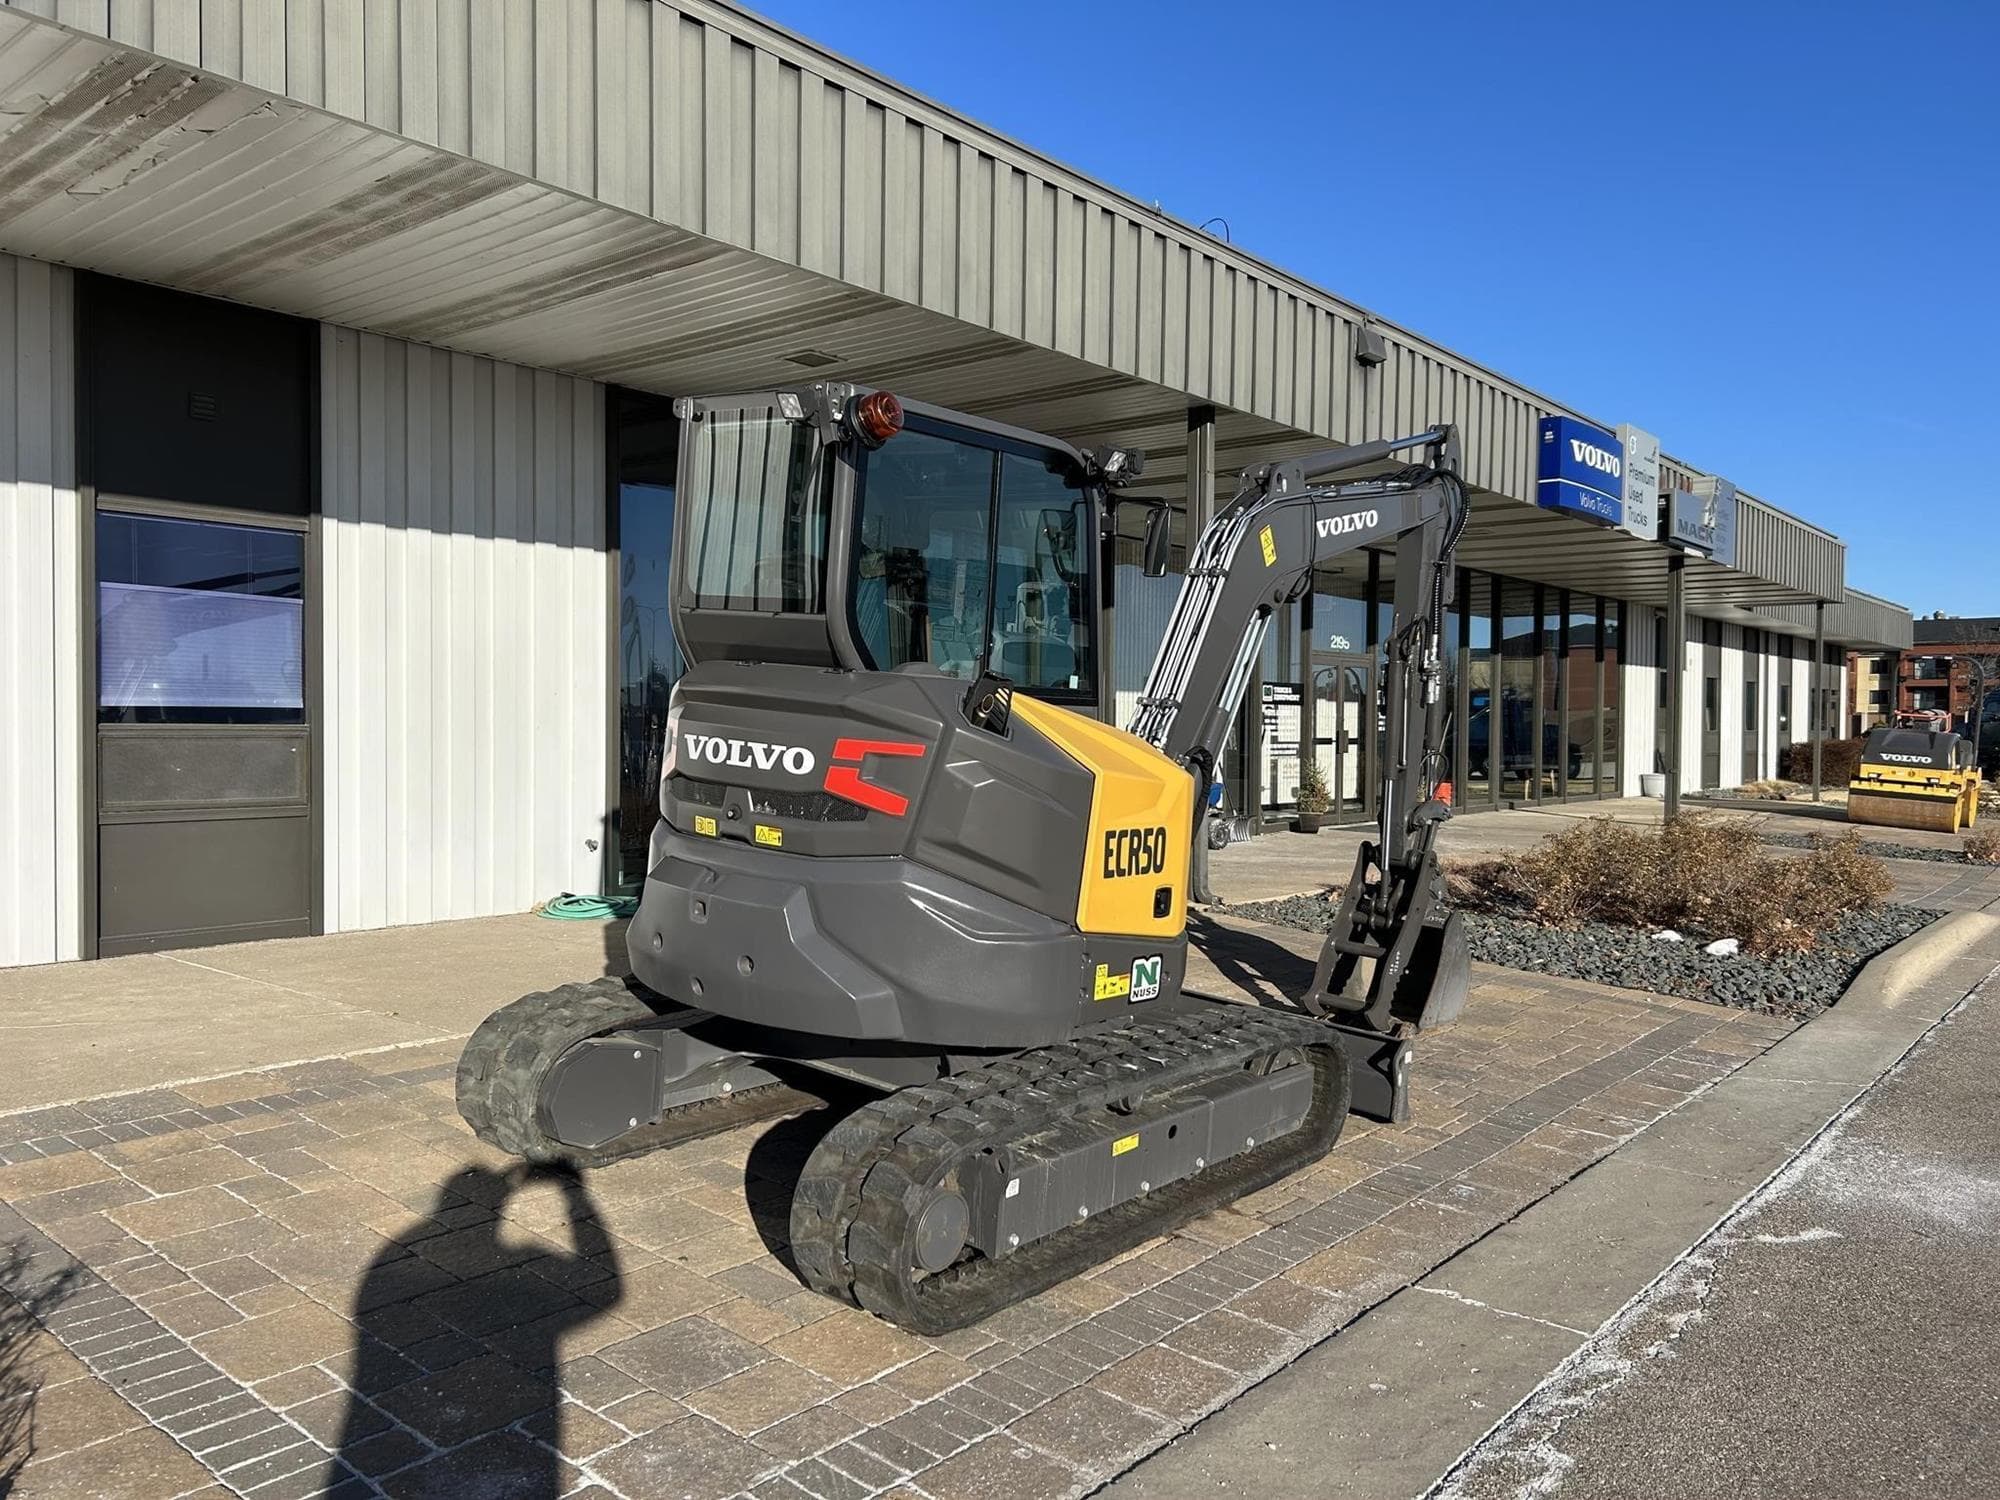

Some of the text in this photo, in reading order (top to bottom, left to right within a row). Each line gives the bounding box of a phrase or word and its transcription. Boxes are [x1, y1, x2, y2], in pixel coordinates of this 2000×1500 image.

[1570, 439, 1620, 478] VOLVO
[1628, 462, 1656, 488] Premium
[1579, 491, 1596, 510] Volvo
[1628, 484, 1644, 504] Used
[1316, 509, 1378, 538] VOLVO
[1628, 505, 1648, 527] Trucks
[684, 733, 816, 776] VOLVO
[1880, 753, 1932, 765] VOLVO
[1103, 827, 1167, 879] ECR50
[1135, 961, 1159, 988] N
[1132, 986, 1157, 999] NUSS
